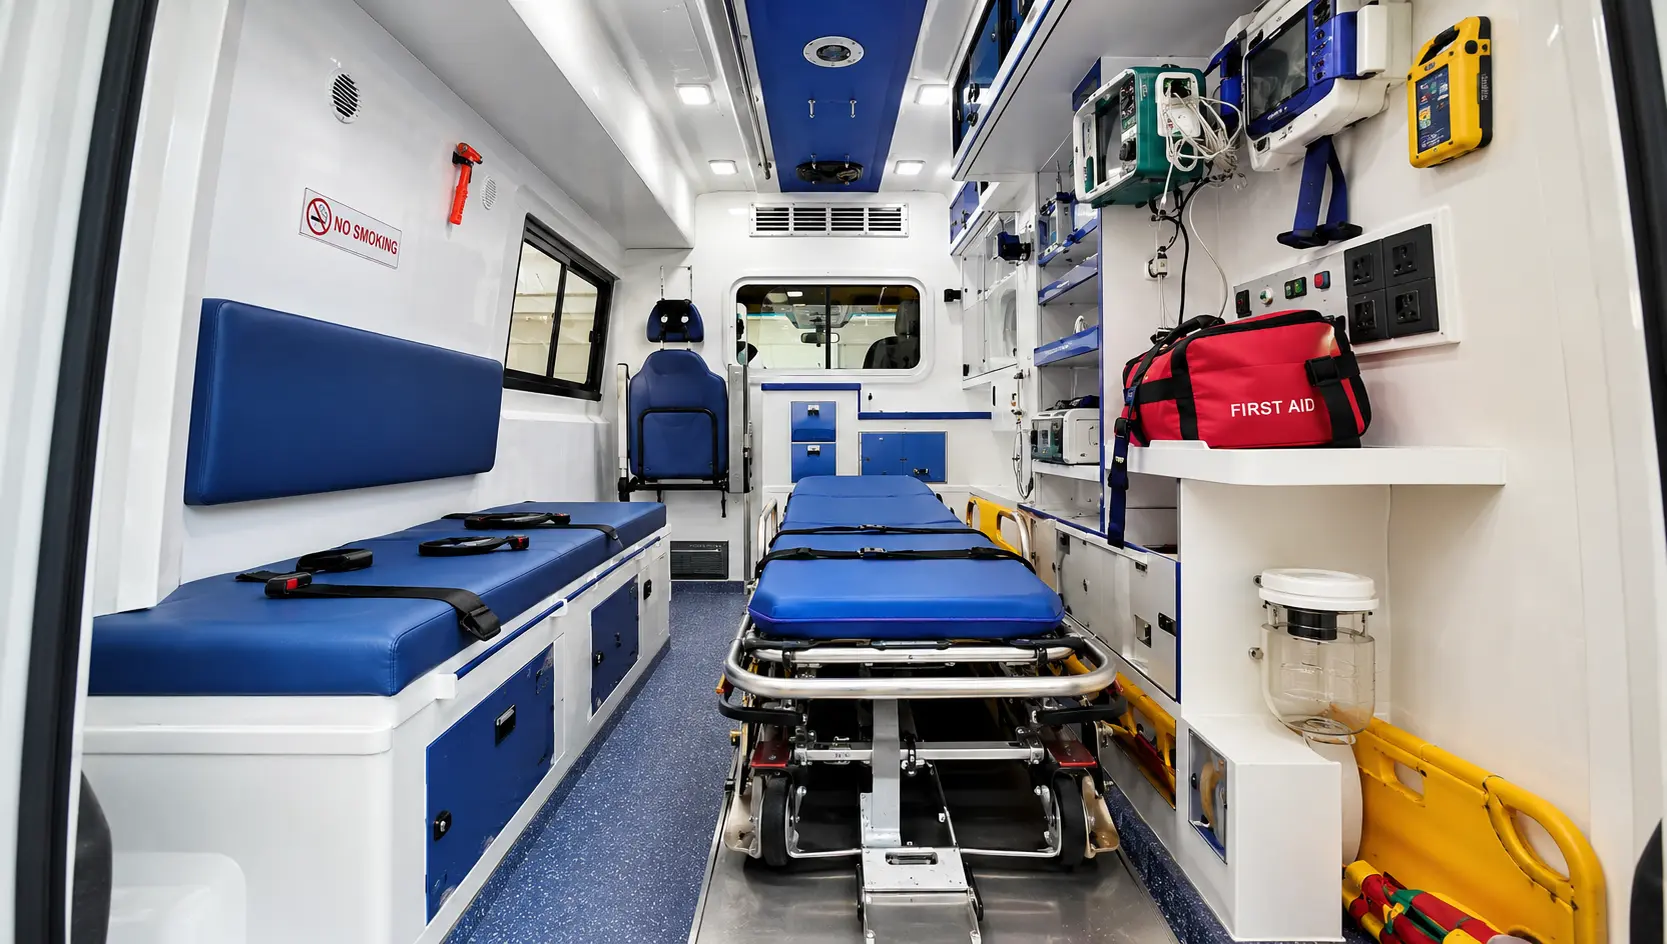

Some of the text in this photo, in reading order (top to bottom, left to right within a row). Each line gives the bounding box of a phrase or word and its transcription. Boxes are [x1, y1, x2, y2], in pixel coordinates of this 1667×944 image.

[334, 215, 398, 255] NO SMOKING
[1230, 398, 1315, 417] FIRST AID
